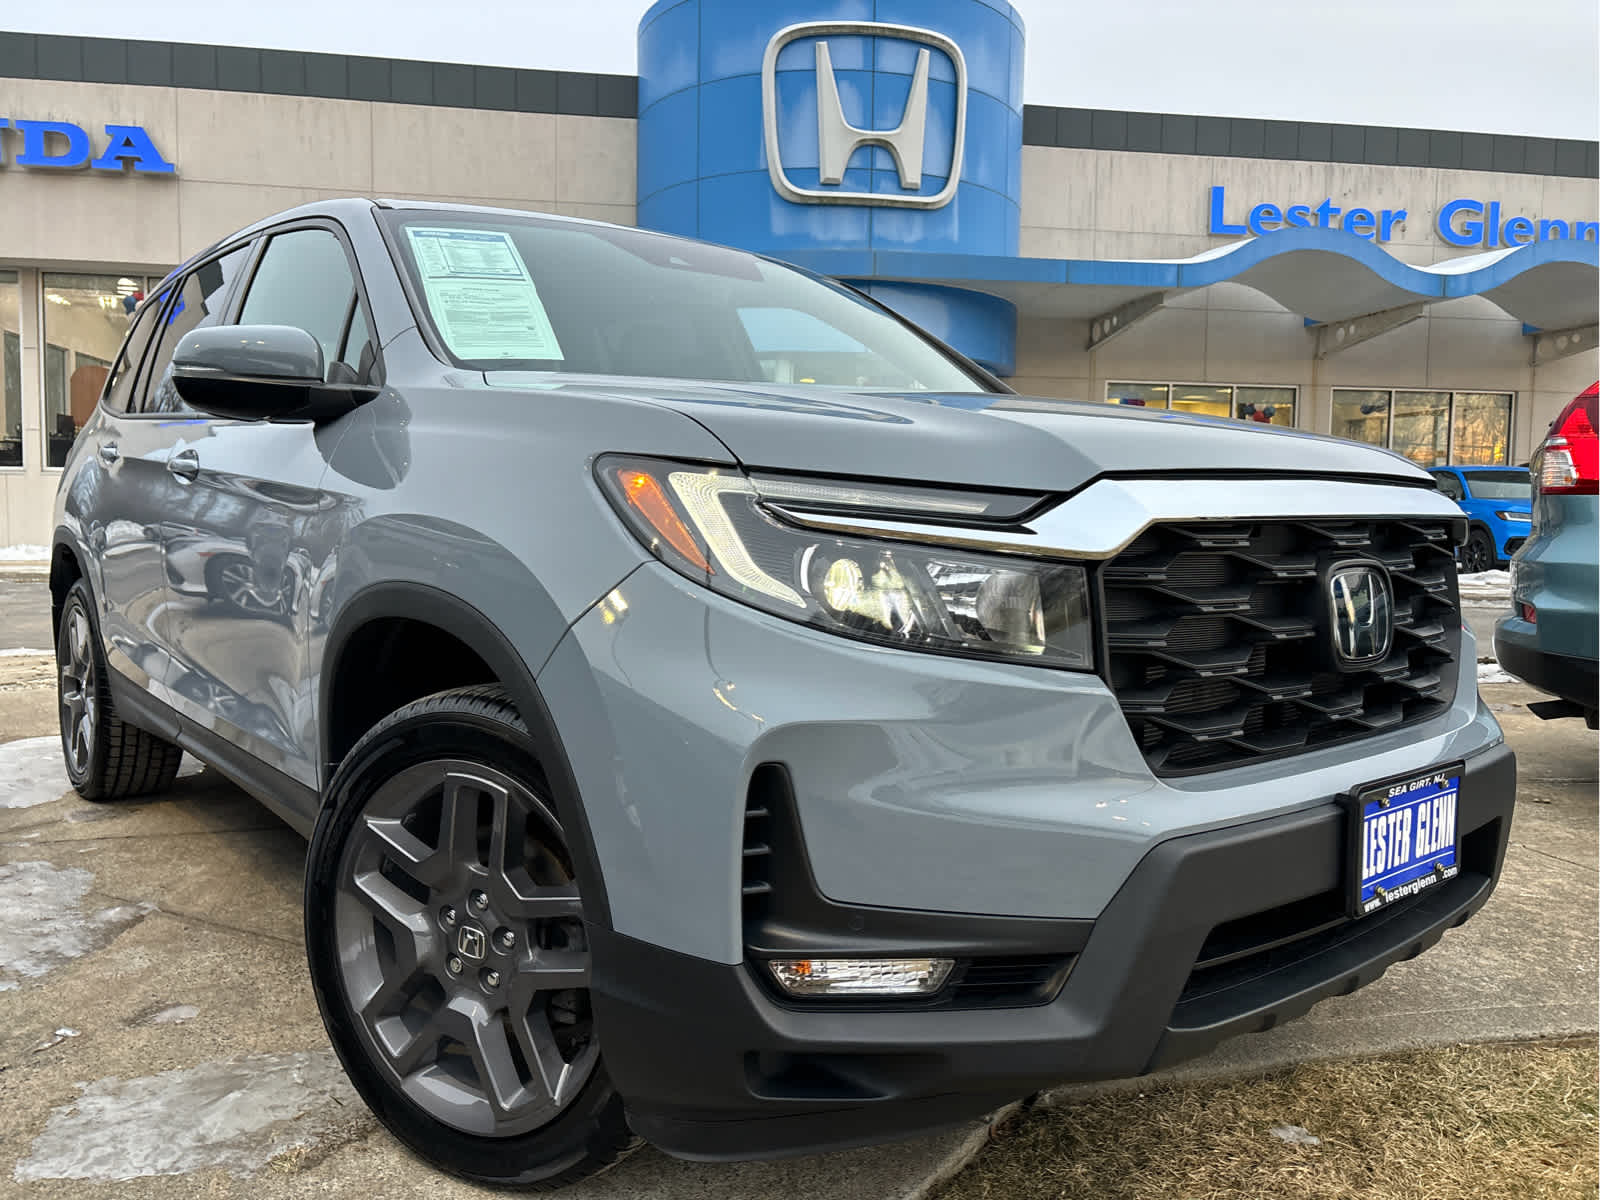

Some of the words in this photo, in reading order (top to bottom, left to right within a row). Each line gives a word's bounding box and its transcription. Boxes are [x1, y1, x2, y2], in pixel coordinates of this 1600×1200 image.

[0, 118, 175, 173] DA
[1209, 186, 1408, 242] Lester
[1438, 198, 1599, 248] Glenn
[1388, 784, 1407, 798] SEA
[1361, 807, 1412, 880] LESTER
[1415, 792, 1457, 859] GLENN
[1384, 874, 1437, 903] lesterglenn
[1442, 866, 1458, 879] .com
